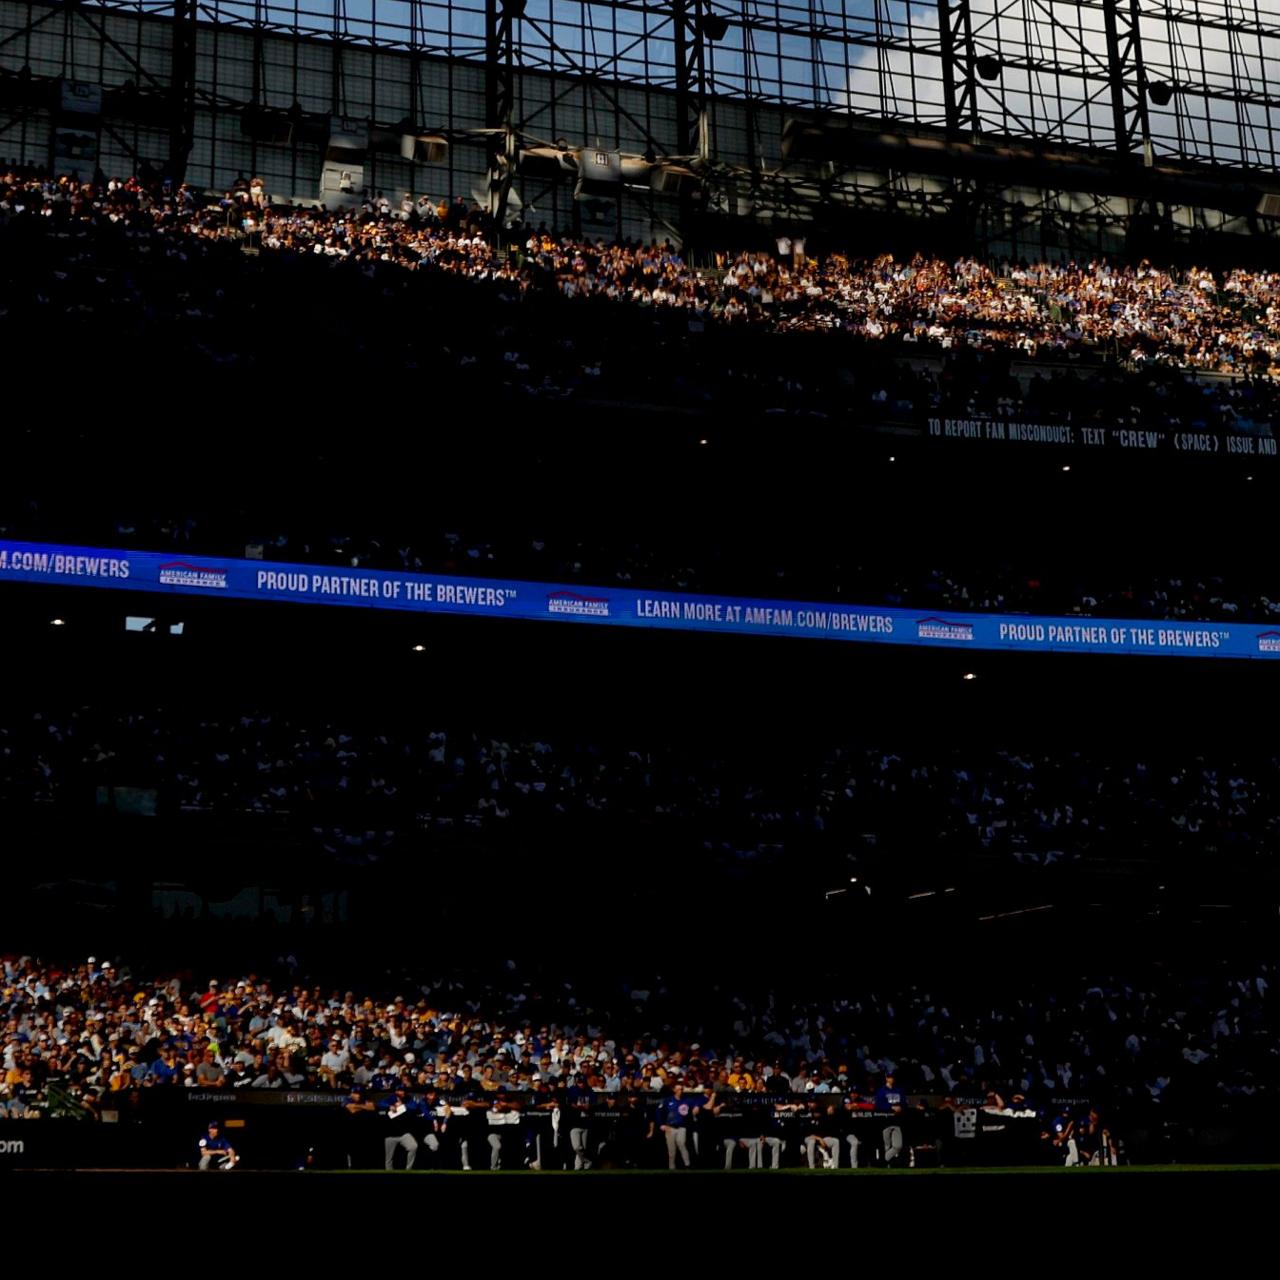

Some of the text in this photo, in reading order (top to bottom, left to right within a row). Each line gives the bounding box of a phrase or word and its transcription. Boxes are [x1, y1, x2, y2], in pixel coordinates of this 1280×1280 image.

[928, 419, 942, 436] TO
[945, 420, 982, 439] REPORT
[985, 422, 1006, 440] FAN
[1008, 423, 1075, 445] MISCONDUCT:
[1082, 427, 1106, 446] TEXT
[1174, 433, 1219, 453] (SPACE)
[1226, 436, 1255, 454] ISSUE
[1258, 438, 1278, 456] AND
[257, 570, 308, 592] PROUD
[312, 574, 379, 597] PARTNER
[383, 580, 401, 599] OF
[404, 582, 433, 602] THE
[637, 599, 893, 633] LEARN MORE AT AMFAM.COM/BREWERS
[999, 623, 1045, 641] PROUD
[1048, 625, 1105, 644] PARTNER
[1109, 627, 1127, 645] OF
[1130, 629, 1155, 646] THE
